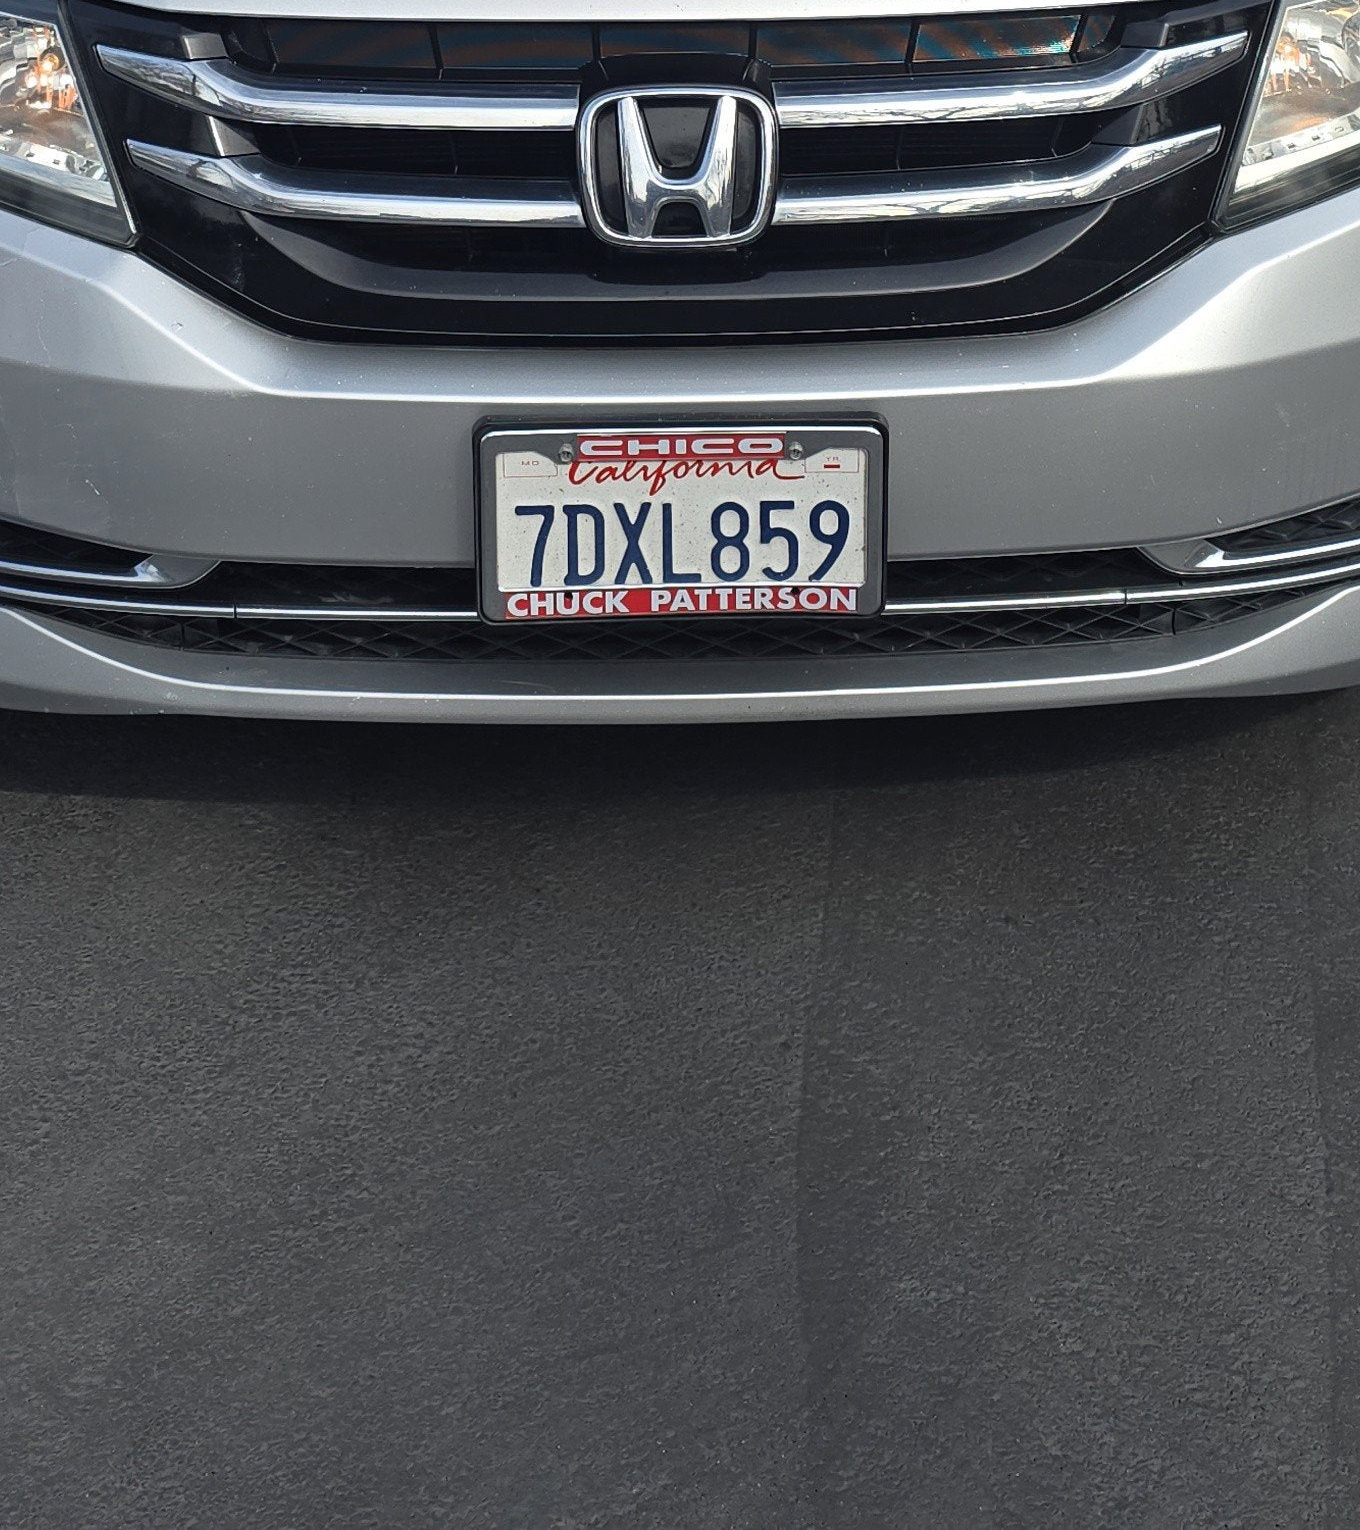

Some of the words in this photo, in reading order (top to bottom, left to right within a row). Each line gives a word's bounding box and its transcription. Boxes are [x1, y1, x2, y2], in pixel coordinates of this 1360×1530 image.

[580, 437, 784, 456] CHICO
[514, 500, 850, 587] 7DXL859
[506, 590, 630, 617] CHUCK
[650, 587, 857, 615] PATTERSON
